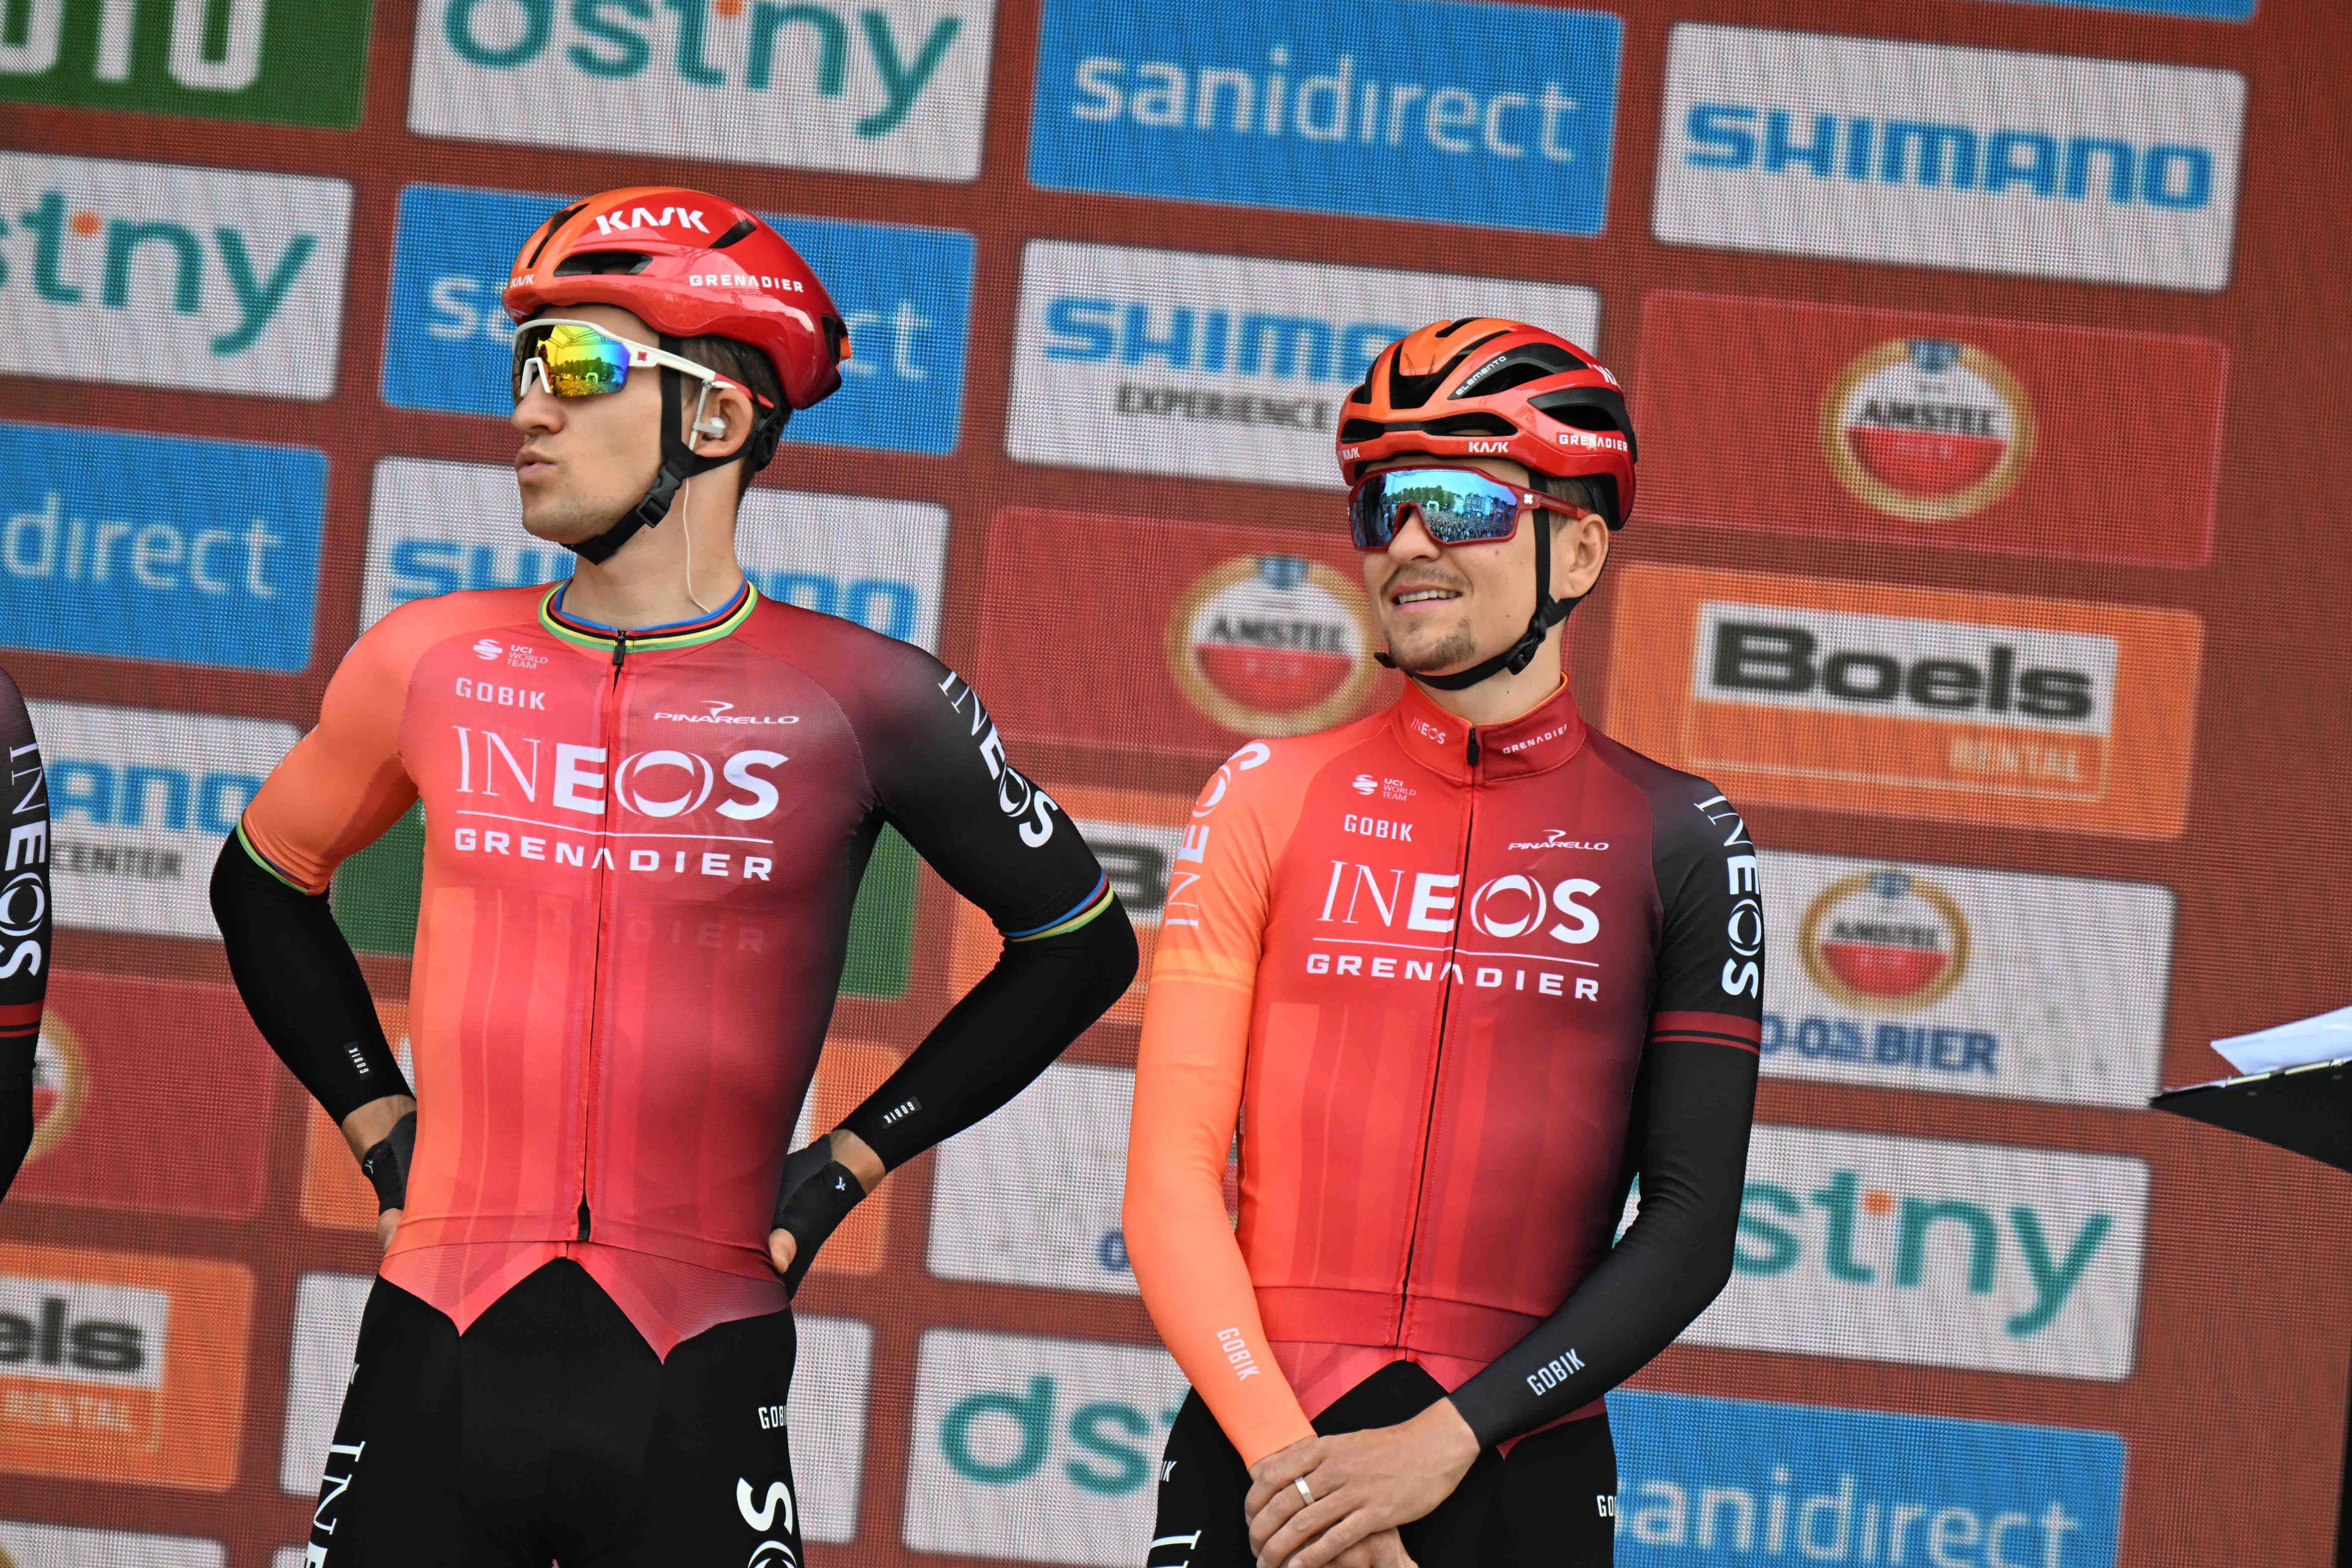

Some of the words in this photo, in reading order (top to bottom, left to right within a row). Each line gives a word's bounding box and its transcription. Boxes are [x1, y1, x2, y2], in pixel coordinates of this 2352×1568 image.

[1071, 43, 1579, 163] sanidirect
[1683, 101, 2214, 211] SHIMANO
[595, 206, 709, 235] KASK
[0, 189, 320, 358] tny
[510, 273, 534, 288] KASK
[688, 274, 804, 293] GRENADIER
[1043, 295, 1396, 385] SHIMA
[1116, 383, 1331, 431] EXPERIENCE
[1860, 399, 1996, 436] AMSTEL
[1468, 441, 1509, 453] KASK
[1559, 434, 1627, 452] GRENADIER
[510, 644, 533, 654] UCI
[1208, 617, 1346, 654] AMSTEL
[507, 658, 537, 669] TEAM
[509, 652, 548, 664] WORLD
[1713, 621, 2093, 720] Boels
[455, 677, 546, 710] GOBIK
[653, 710, 799, 724] PINARELLO
[1411, 717, 1446, 744] INEOS
[451, 725, 789, 821] INEOS
[938, 671, 1058, 848] INEOS
[1949, 736, 2084, 782] RENTAL
[1382, 791, 1407, 801] TEAM
[1383, 785, 1417, 796] WORLD
[1384, 777, 1403, 786] UCI
[1343, 814, 1413, 842] GOBIK
[1508, 841, 1608, 851] PINARELLO
[454, 828, 772, 881] GRENADIER
[1317, 860, 1601, 944] INEOS
[1694, 795, 1762, 999] INEOS
[1833, 920, 1939, 948] AMSTEL
[1306, 954, 1599, 1002] GRENADIER
[348, 1047, 369, 1074] GOBIK
[1875, 1023, 1998, 1076] BIER
[883, 1101, 914, 1123] GOBIK
[1732, 1169, 2114, 1338] stny
[1218, 1327, 1259, 1381] GOBIK
[1526, 1348, 1585, 1397] GOBIK
[1617, 1466, 2079, 1568] anidirect
